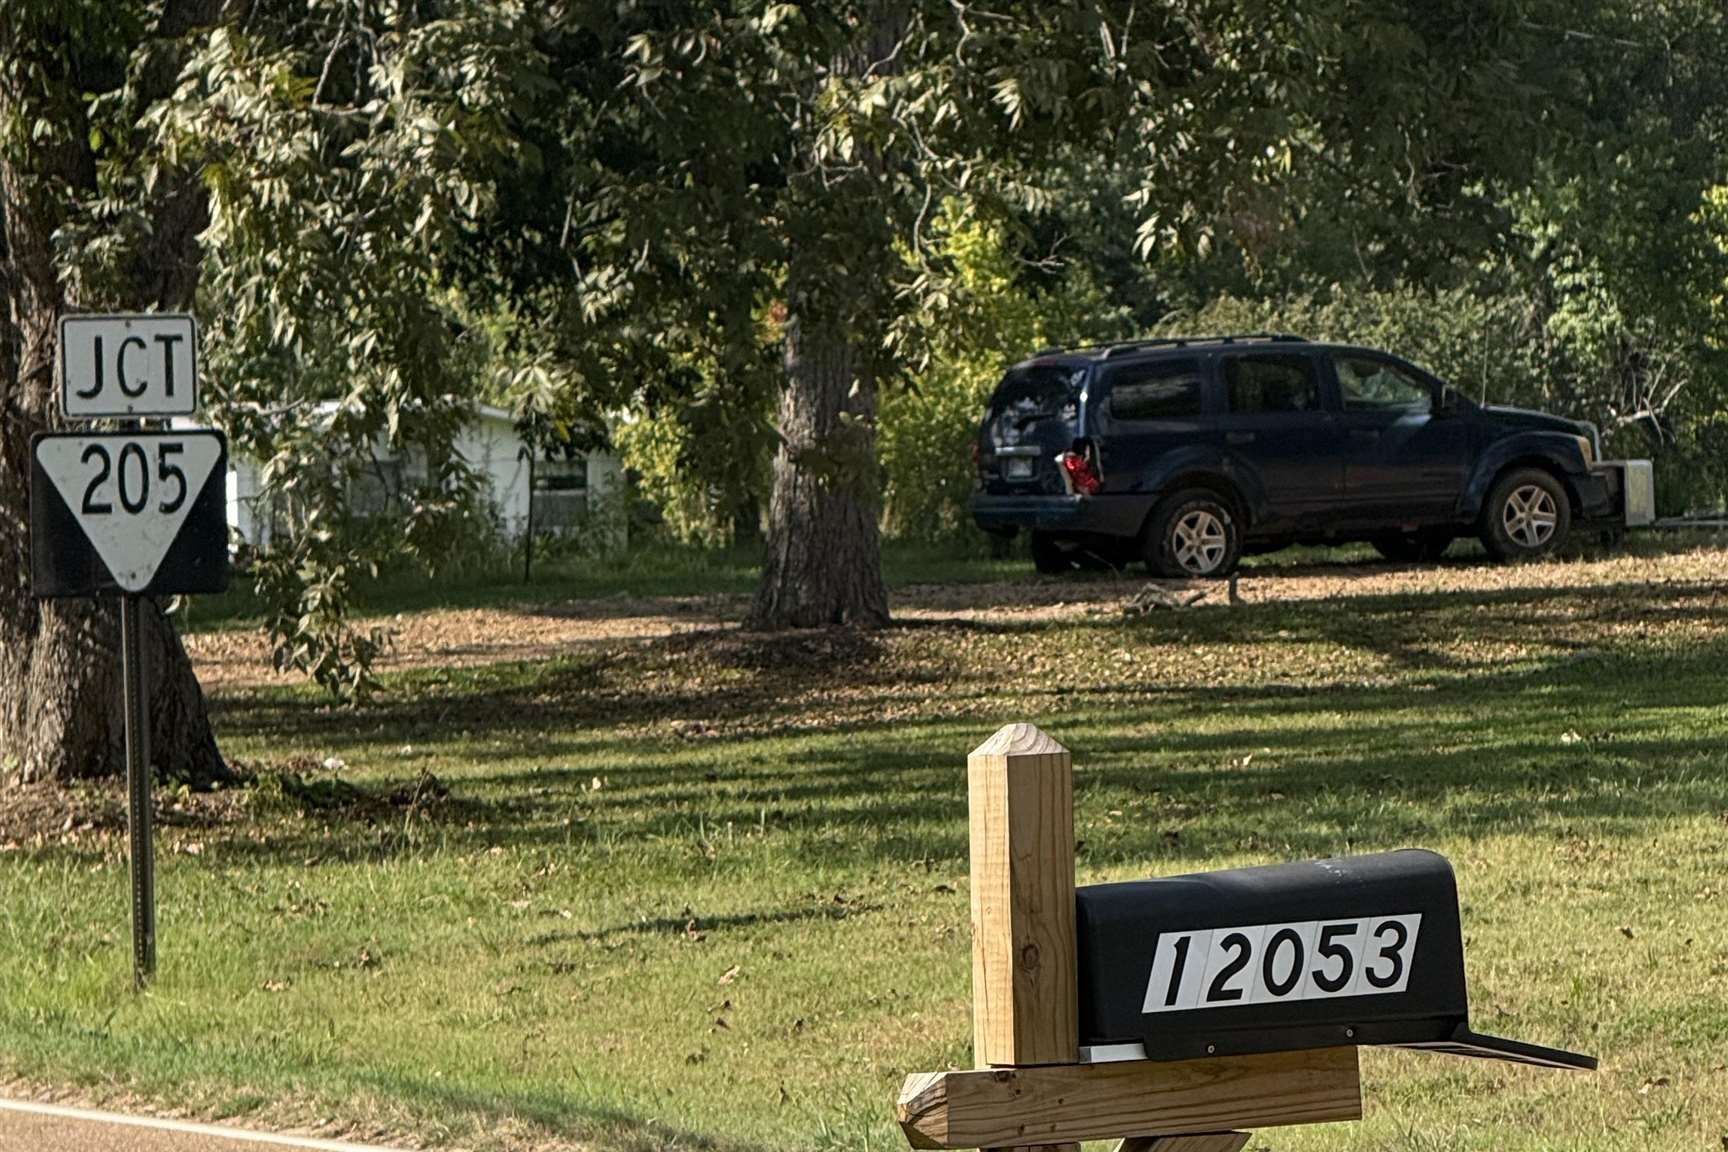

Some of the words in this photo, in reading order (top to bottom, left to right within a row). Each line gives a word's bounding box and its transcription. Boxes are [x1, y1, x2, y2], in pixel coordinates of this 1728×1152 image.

[76, 334, 183, 399] JCT
[81, 442, 187, 515] 205
[1164, 920, 1408, 1006] 12053
